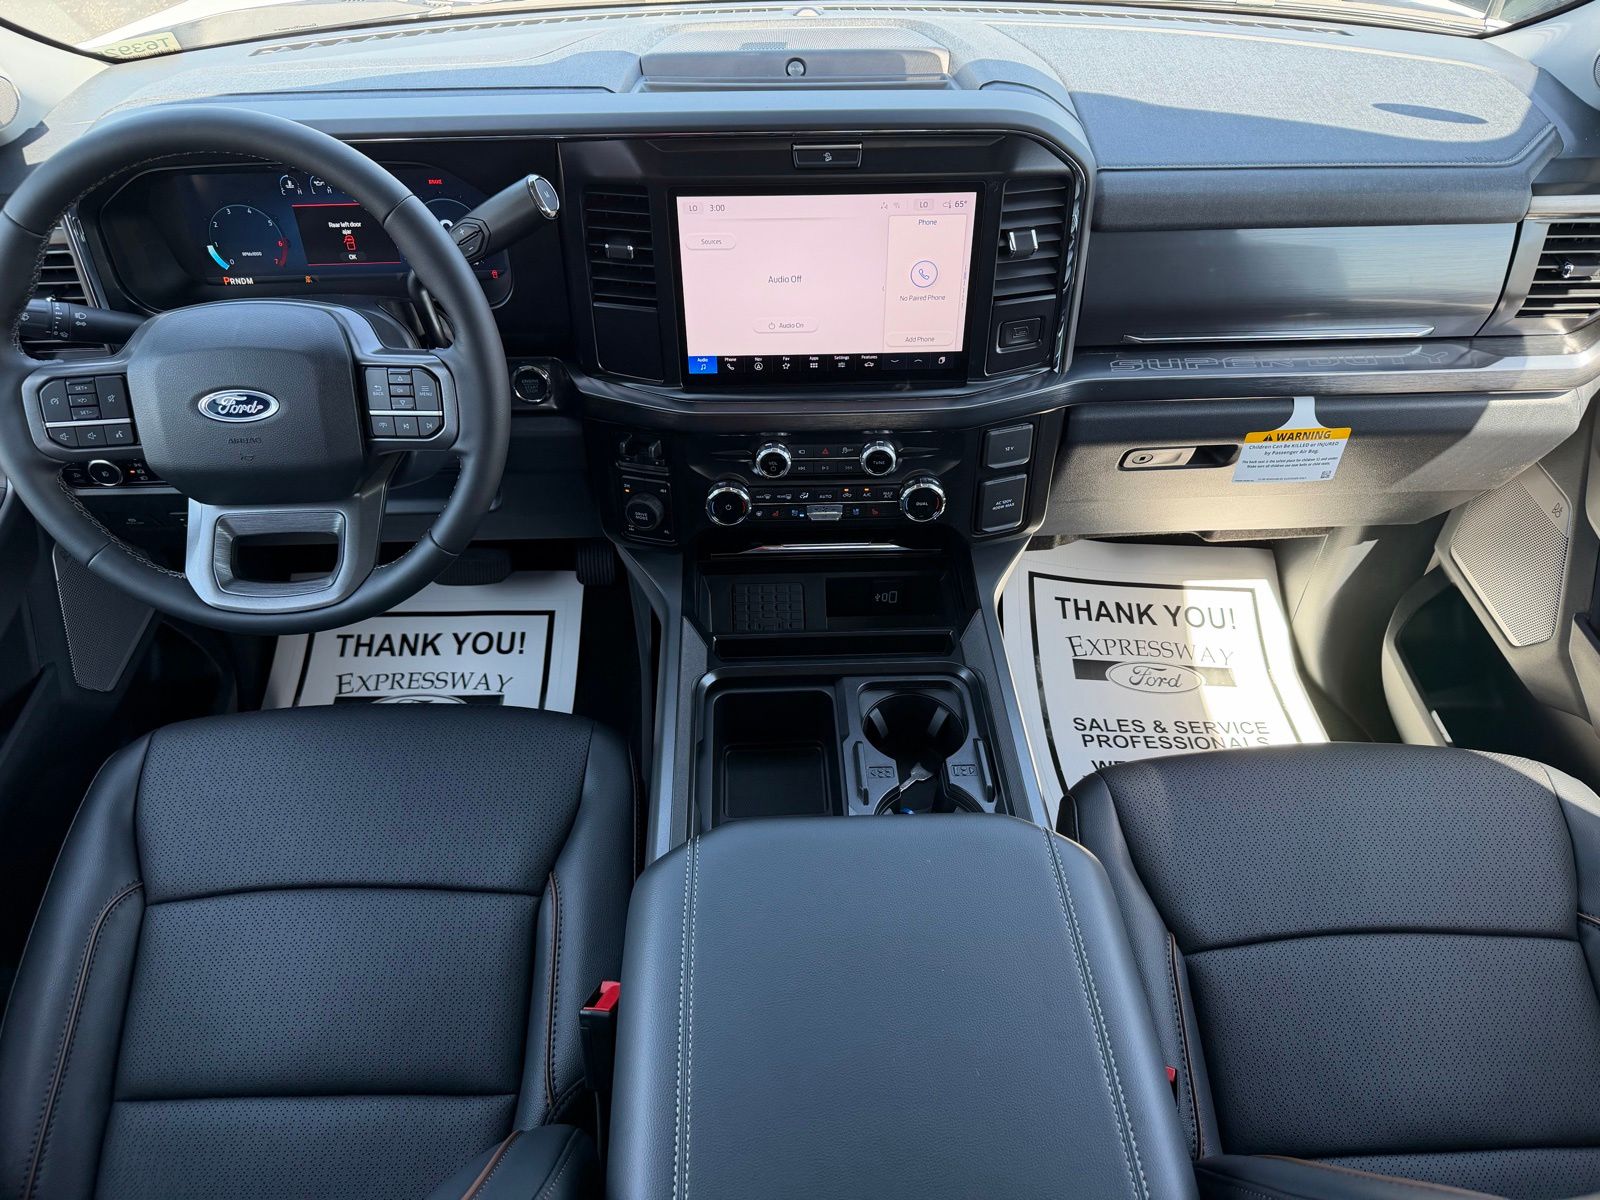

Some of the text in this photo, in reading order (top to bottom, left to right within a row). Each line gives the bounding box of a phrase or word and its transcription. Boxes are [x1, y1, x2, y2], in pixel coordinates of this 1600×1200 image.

[919, 201, 929, 209] LO
[918, 218, 937, 226] Phone
[700, 238, 722, 246] Sources
[767, 275, 802, 284] Audio Off
[908, 294, 927, 302] Paired
[1109, 355, 1295, 373] SUPER
[214, 394, 264, 415] Ford
[1275, 430, 1332, 442] WARNING
[1054, 596, 1237, 630] THANK YOU!
[336, 631, 527, 658] THANK YOU!
[1065, 635, 1235, 666] EXPRESSWAY
[336, 671, 514, 695] EXPRESSWAY
[1128, 664, 1183, 690] Ford
[1073, 716, 1270, 735] SALES & SERVICE
